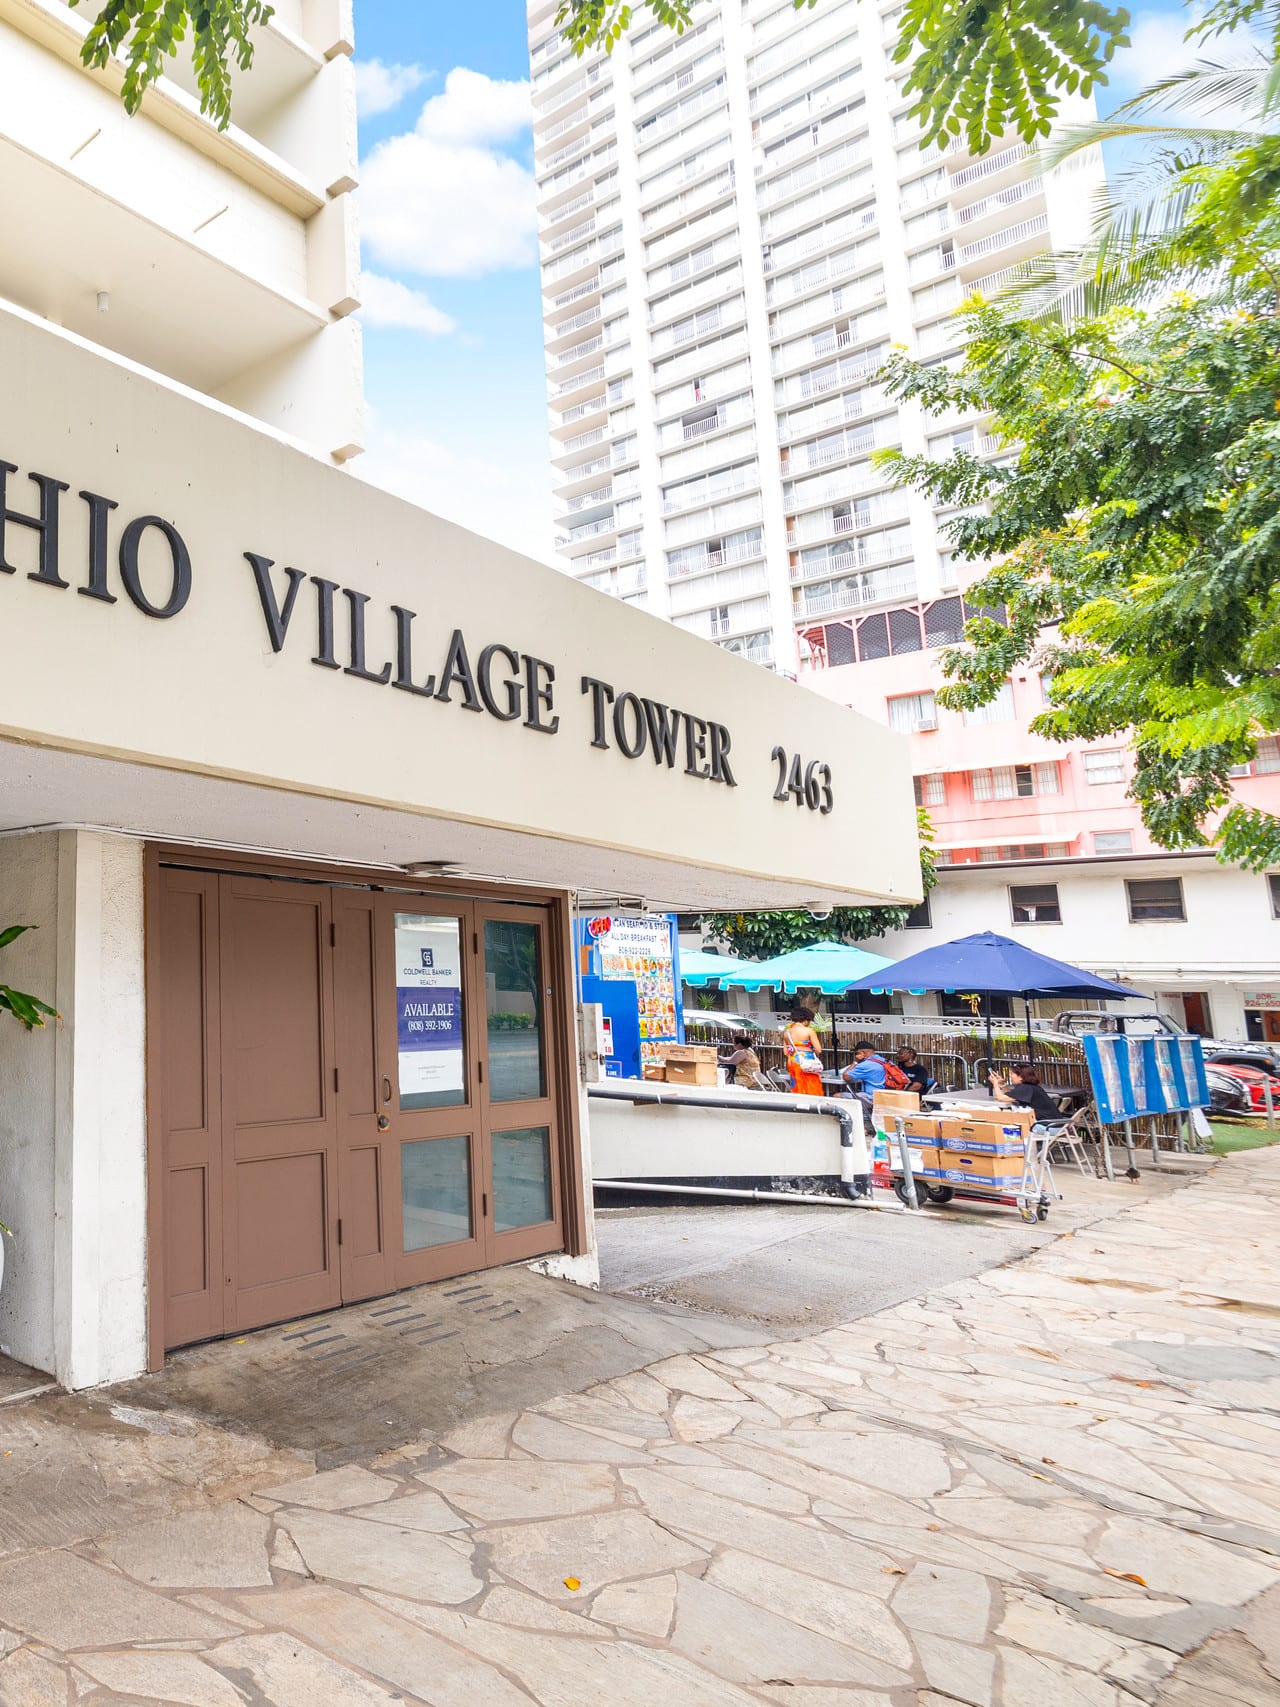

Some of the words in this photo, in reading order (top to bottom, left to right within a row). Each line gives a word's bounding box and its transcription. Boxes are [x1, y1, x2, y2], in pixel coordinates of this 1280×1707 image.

[243, 551, 560, 735] VILLAGE
[581, 676, 737, 787] TOWER
[771, 745, 834, 815] 2463
[591, 917, 612, 935] OPEN
[403, 968, 431, 976] COLDWELL
[432, 968, 452, 976] BANKER
[404, 1003, 455, 1017] AVAILABLE
[407, 1020, 424, 1032] (808)
